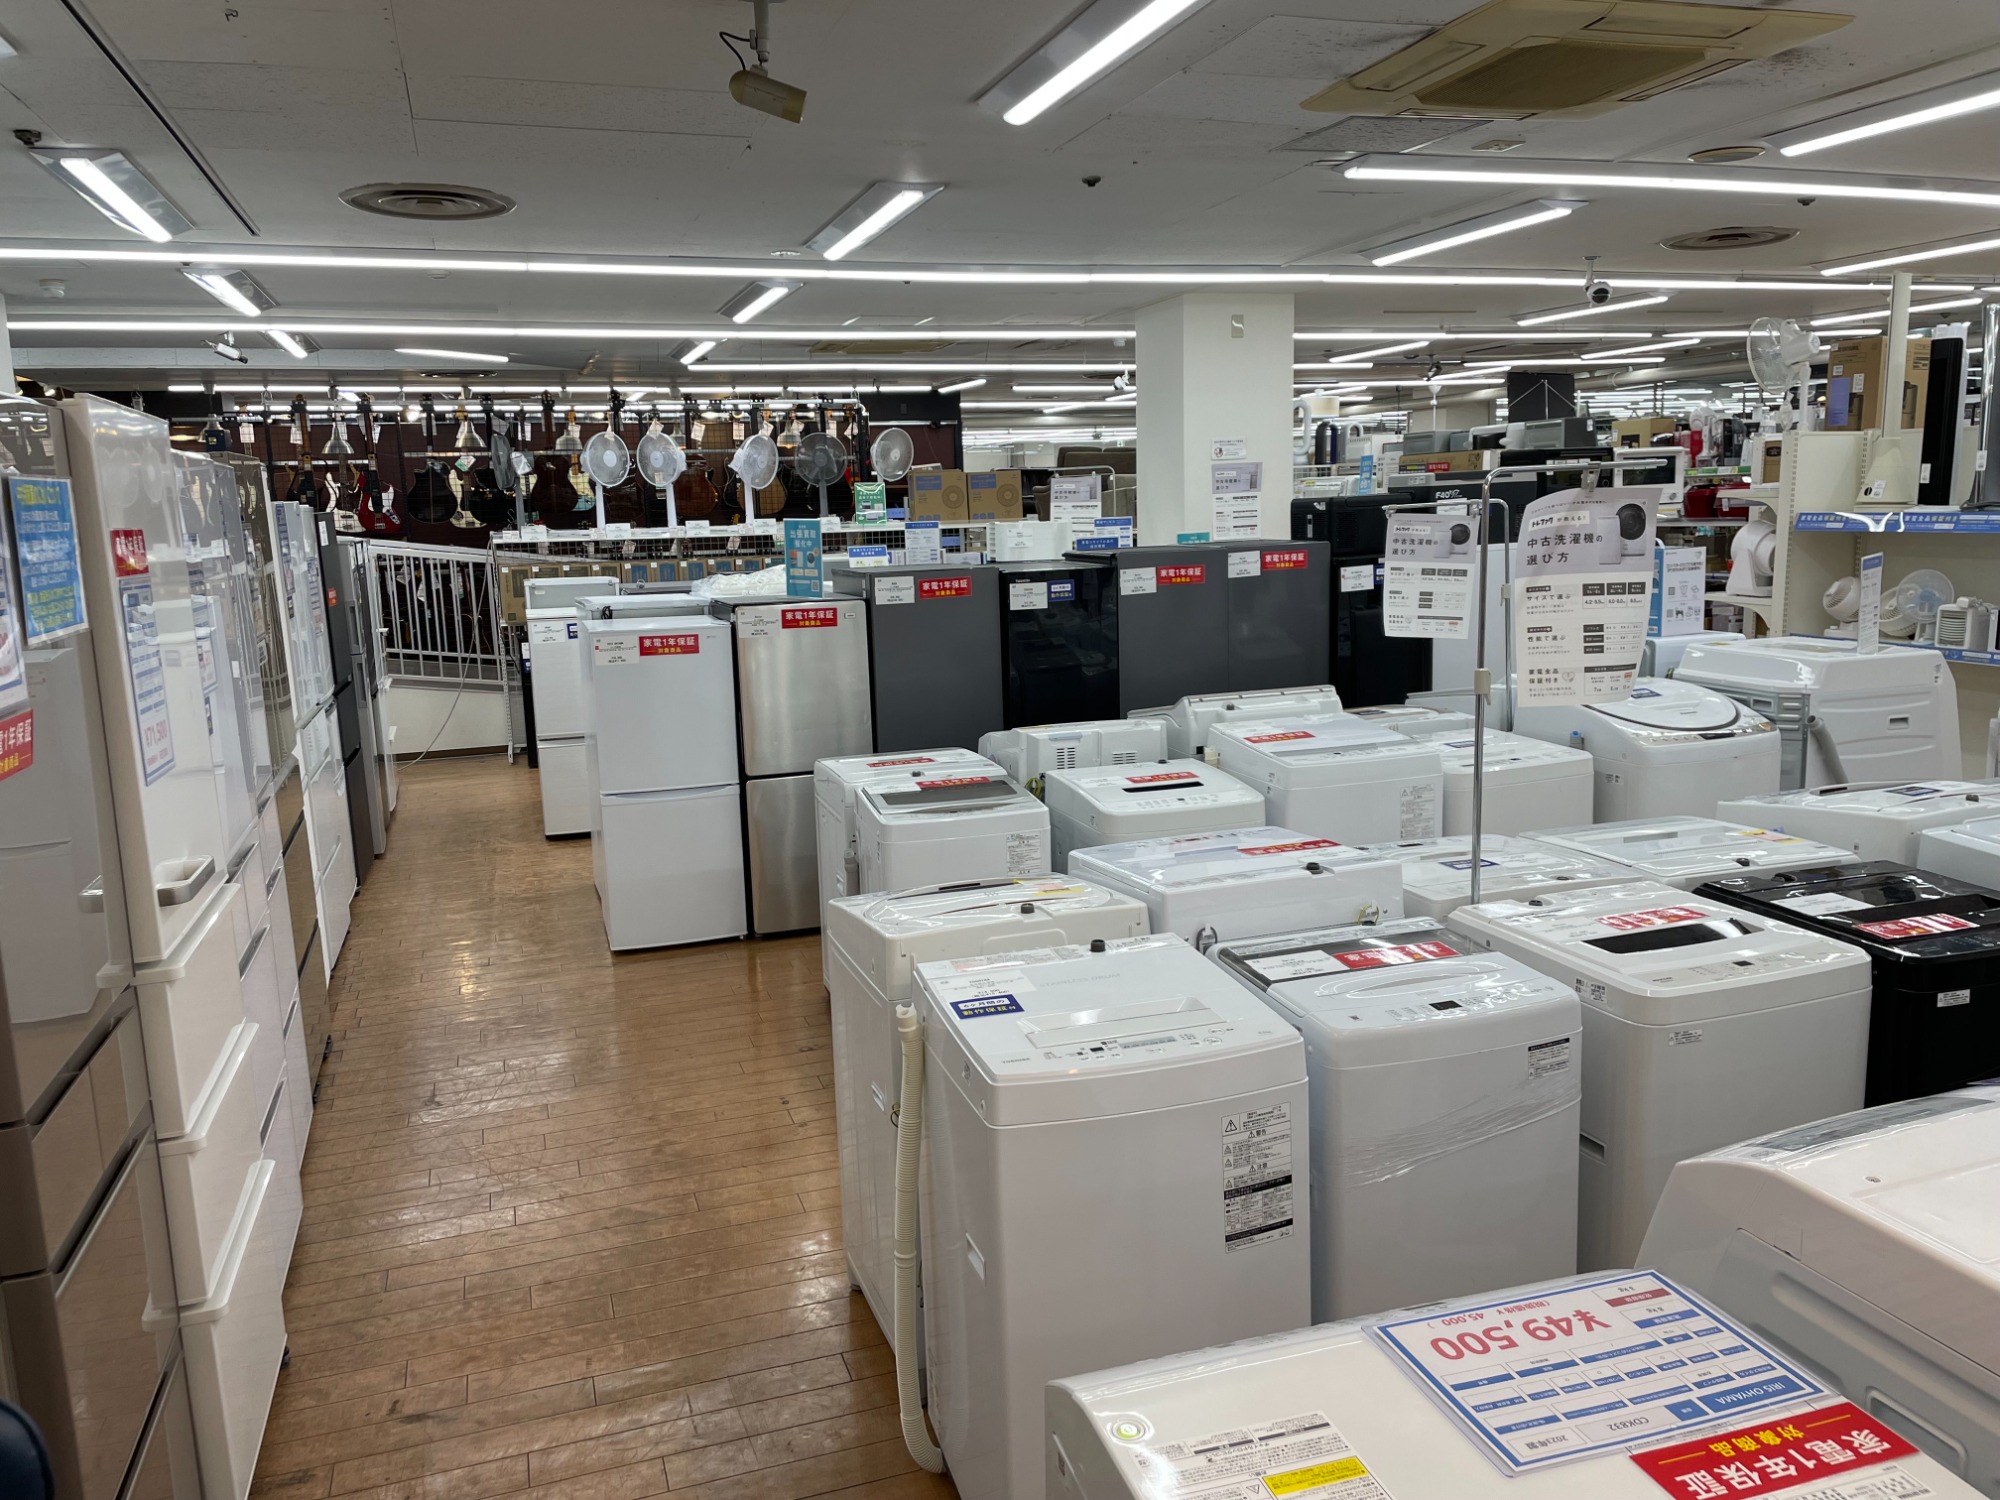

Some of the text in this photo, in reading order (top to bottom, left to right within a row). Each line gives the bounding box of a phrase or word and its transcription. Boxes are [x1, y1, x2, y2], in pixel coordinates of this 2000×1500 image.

[1532, 516, 1553, 528] トレファク
[1392, 538, 1438, 546] 中古洗濯機の
[1527, 533, 1602, 549] 中古洗濯機の
[1392, 548, 1416, 556] 選び方
[1265, 553, 1304, 563] 家電1年保証
[1526, 552, 1569, 566] 選び方
[1160, 567, 1202, 577] 家電1年保証
[922, 580, 968, 590] 家電1年保証
[1526, 594, 1571, 602] サイズで選ぶ
[786, 610, 834, 620] 家電1年保証
[644, 636, 696, 648] 家電1年保証
[1528, 634, 1566, 643] 性能で選ぶ
[1528, 668, 1560, 676] 家電全品
[144, 718, 168, 748] ¥71,500
[962, 1005, 1016, 1016] 動作保証付
[1256, 1129, 1267, 1137] 警告
[1257, 1162, 1268, 1170] 注意
[1441, 1312, 1484, 1326] 45,000
[1430, 1309, 1612, 1360] ¥49,500
[1715, 1381, 1784, 1404] IRIS OHYAMA
[1608, 1416, 1649, 1431] CDK832
[1525, 1434, 1568, 1450] 2023年製
[1709, 1424, 1808, 1458] 対象商品
[1674, 1429, 1892, 1500] 家電1年保証
